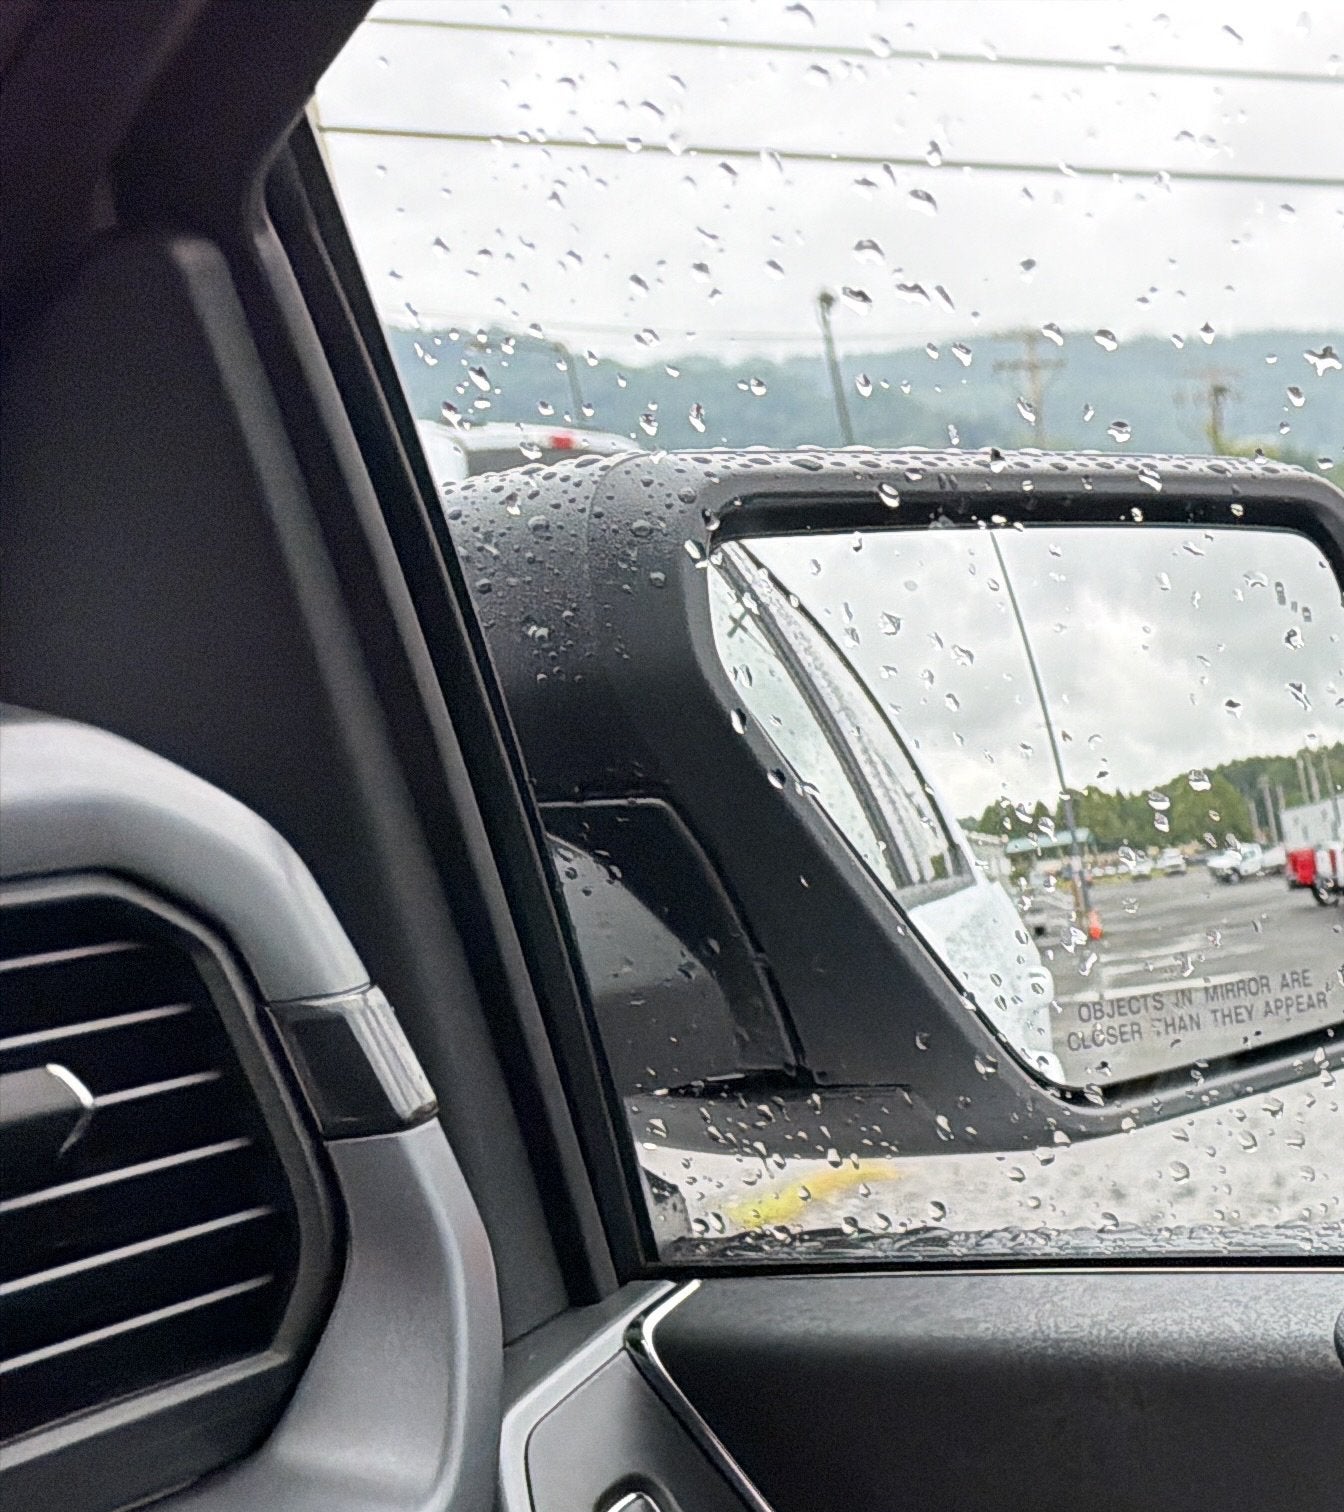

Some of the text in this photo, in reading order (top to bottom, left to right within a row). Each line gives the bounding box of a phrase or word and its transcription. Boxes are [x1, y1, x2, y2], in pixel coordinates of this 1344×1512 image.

[1067, 1022, 1143, 1051] CLOSER
[1211, 1002, 1255, 1027] THEY
[1263, 991, 1328, 1018] APPEAR
[1077, 993, 1165, 1023] OBJECTS
[1203, 975, 1272, 1002] MIRROR
[1279, 969, 1313, 991] ARE
